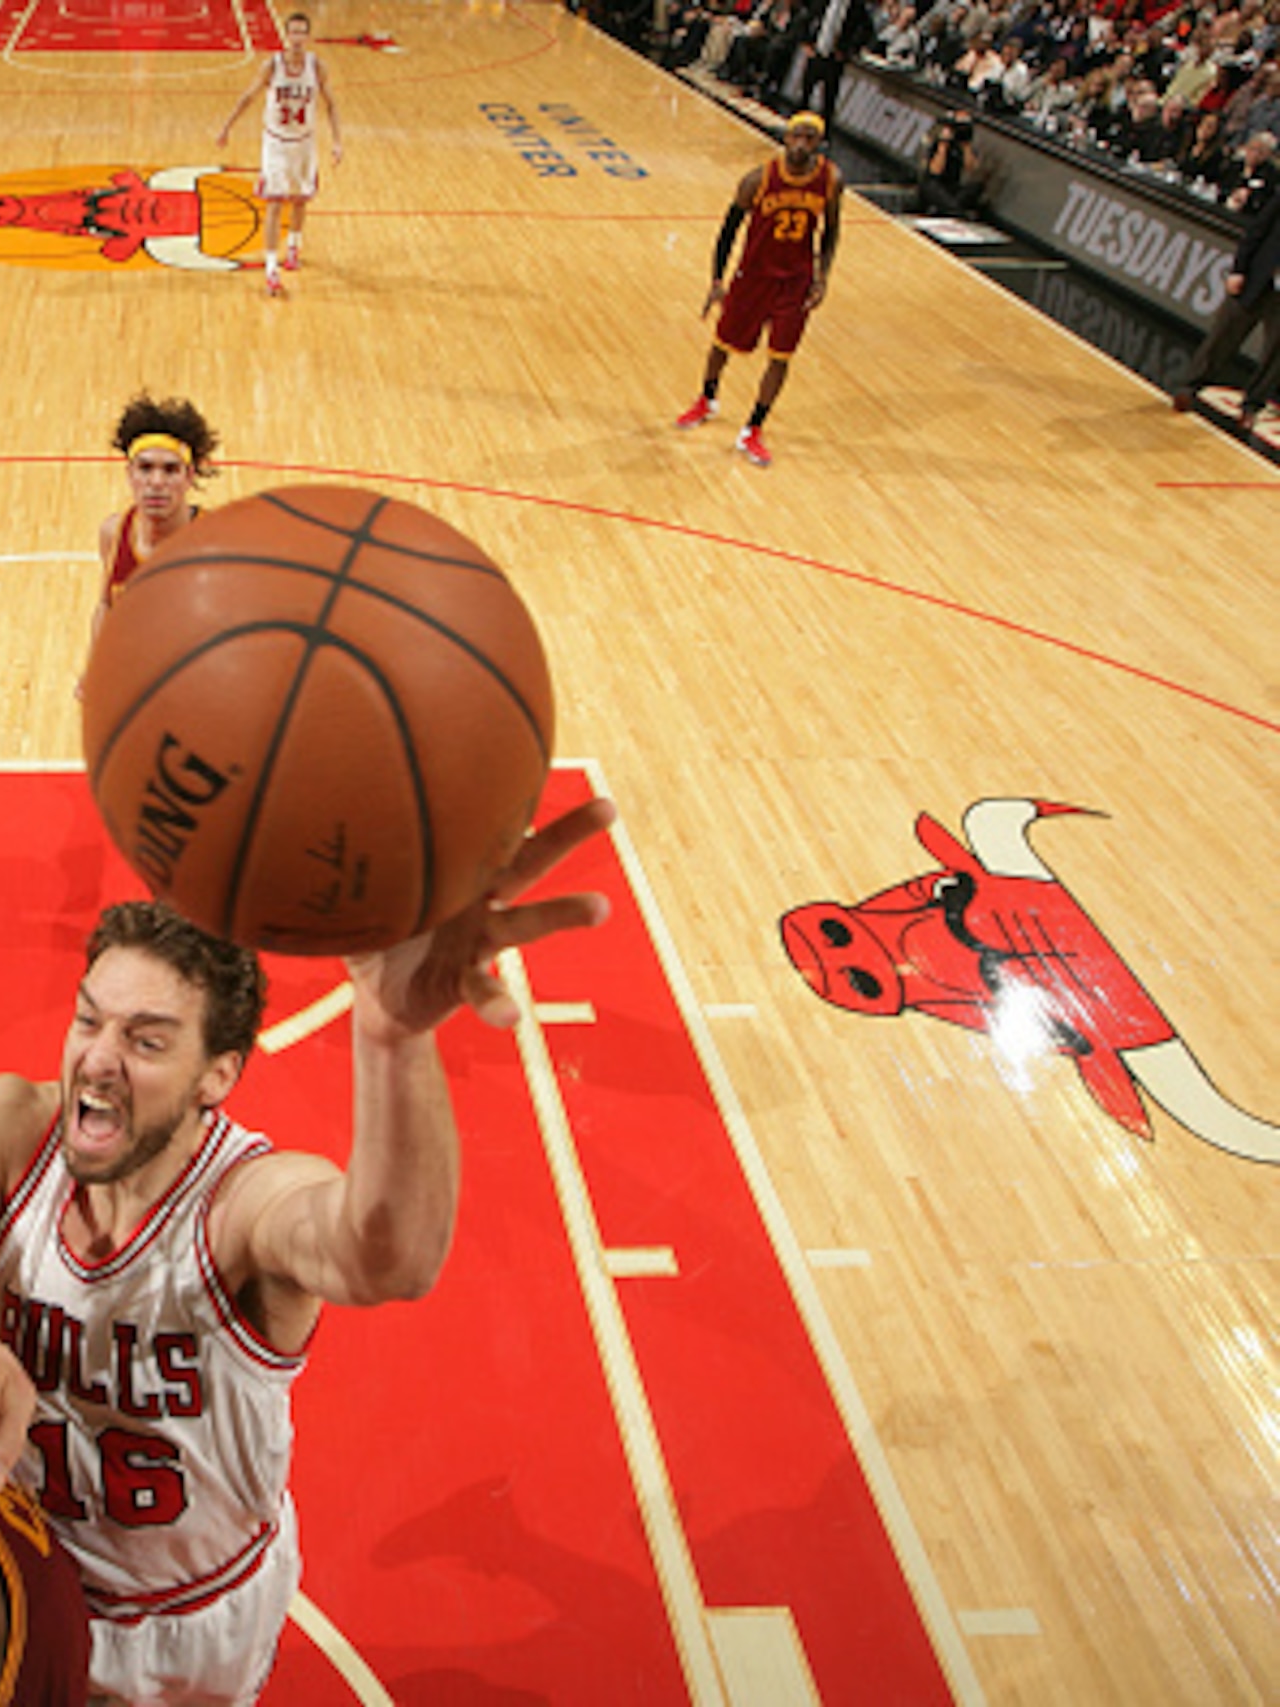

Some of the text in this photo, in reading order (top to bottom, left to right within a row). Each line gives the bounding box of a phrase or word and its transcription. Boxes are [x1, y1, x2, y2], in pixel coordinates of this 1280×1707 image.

[478, 103, 577, 177] CENTER
[538, 103, 649, 181] UNITED
[773, 209, 808, 240] 23
[1053, 178, 1235, 316] TUESDAYS
[27, 1421, 188, 1528] 16
